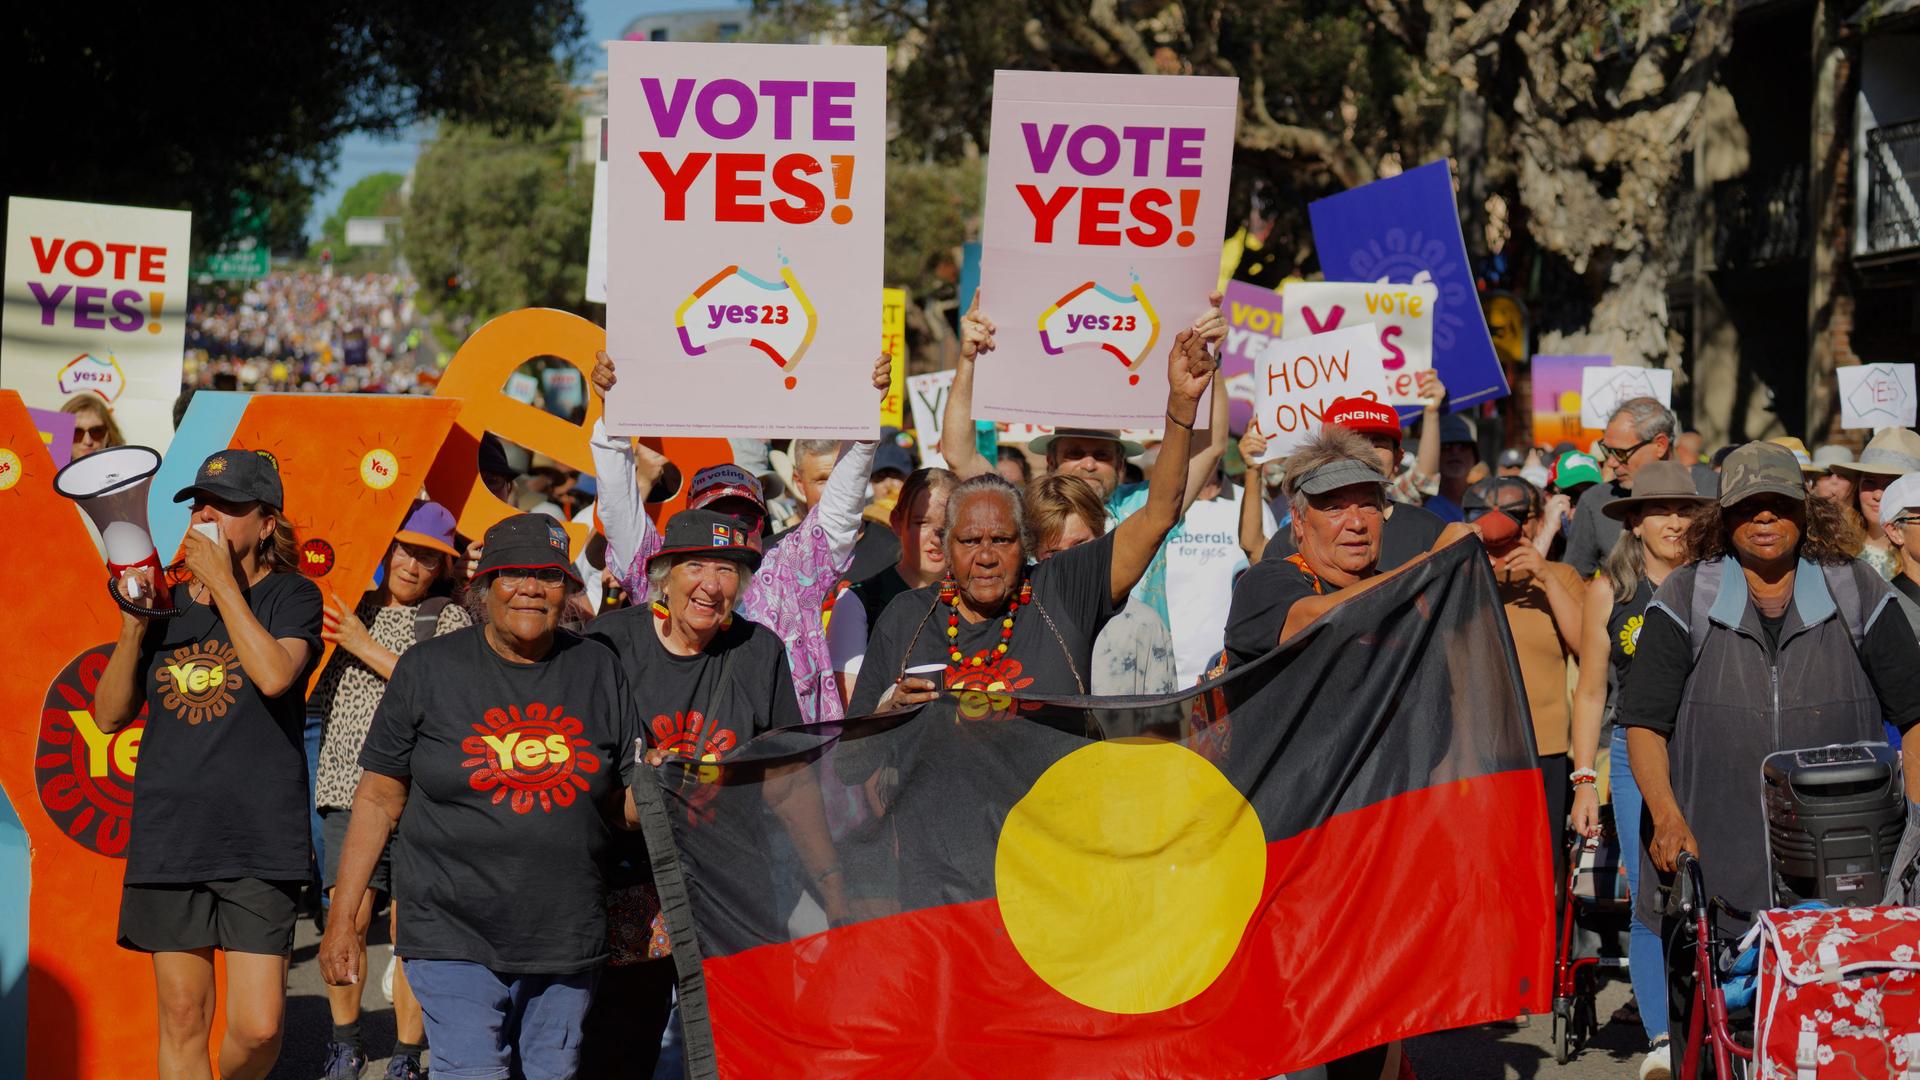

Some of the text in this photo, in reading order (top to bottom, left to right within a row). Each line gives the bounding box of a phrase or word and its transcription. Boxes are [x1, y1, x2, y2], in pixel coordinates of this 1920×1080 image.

[640, 78, 856, 141] VOTE
[1020, 122, 1206, 178] VOTE
[638, 151, 855, 225] YES!
[1015, 184, 1201, 248] YES!
[30, 236, 168, 283] VOTE
[27, 281, 165, 334] YES!
[707, 304, 789, 329] yes23
[1066, 313, 1137, 334] yes23
[1231, 302, 1284, 337] VOT
[1227, 326, 1270, 360] YE
[1302, 305, 1406, 371] YS
[73, 370, 112, 383] yes23
[1268, 349, 1350, 396] HOW
[1333, 410, 1390, 424] ENGINE
[371, 459, 389, 476] Yes
[707, 469, 745, 481] voting
[305, 551, 326, 563] Yes
[1179, 546, 1198, 556] for
[168, 662, 223, 694] Yes
[68, 710, 144, 777] Ye
[481, 732, 570, 771] Yes
